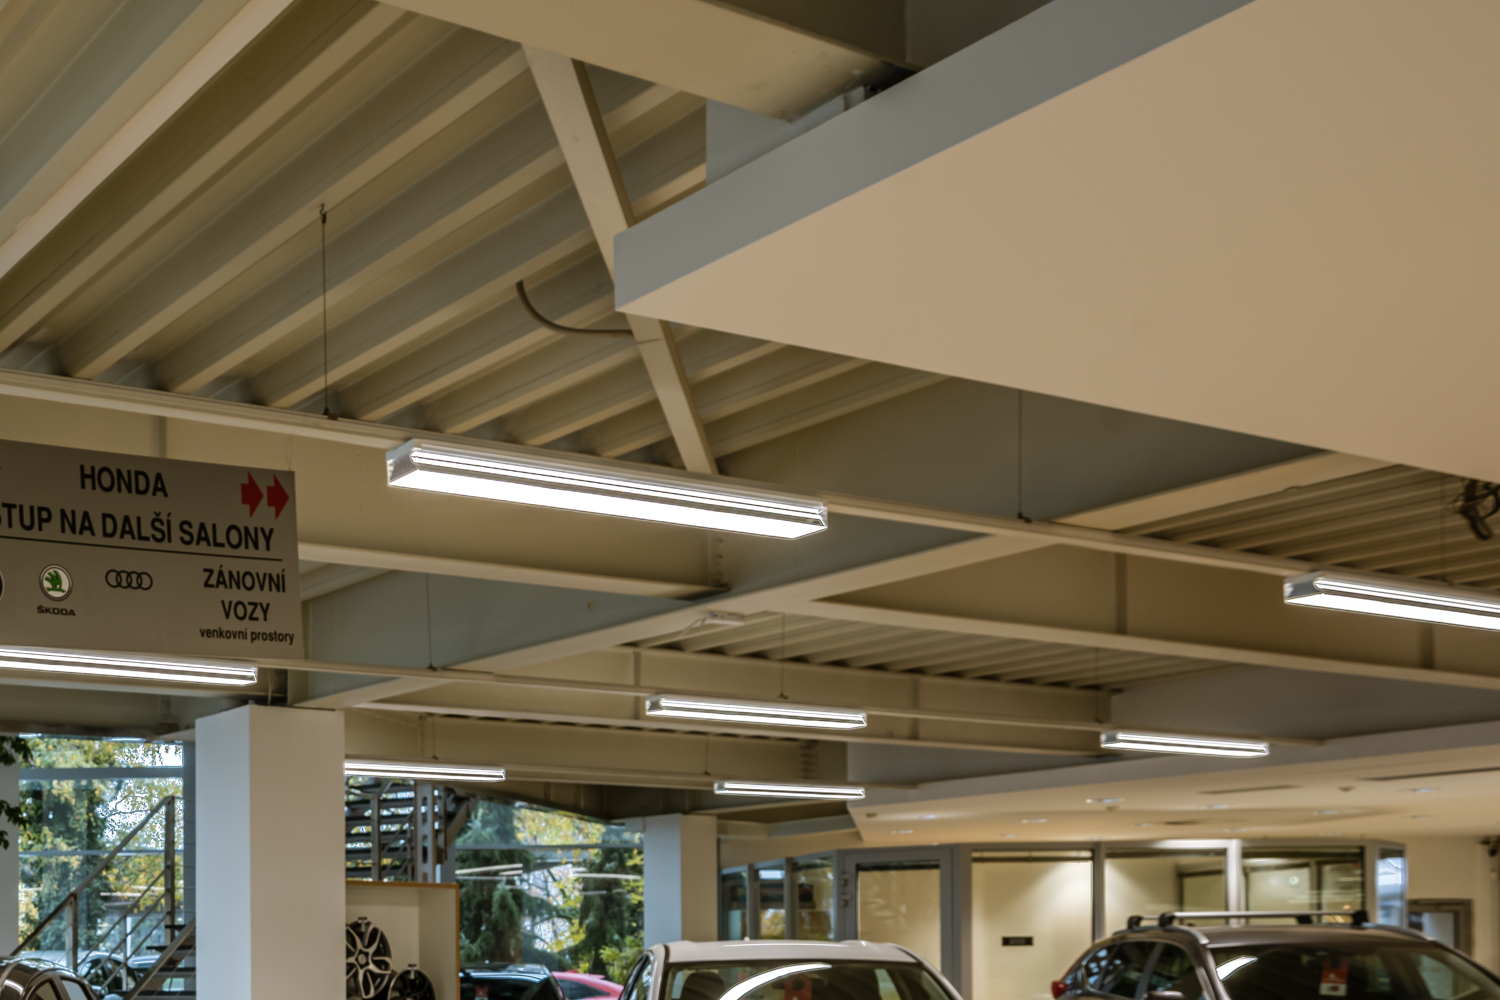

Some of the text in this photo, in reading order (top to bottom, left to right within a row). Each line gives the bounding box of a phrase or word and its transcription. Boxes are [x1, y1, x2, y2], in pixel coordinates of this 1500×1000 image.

[80, 464, 169, 497] HONDA
[60, 508, 95, 537] NA
[102, 511, 172, 544] DALŠÍ
[179, 519, 275, 552] SALONY
[203, 564, 287, 594] ZÁNOVNÍ
[37, 604, 76, 618] ŠKODA
[221, 599, 271, 622] VOZY
[199, 625, 295, 646] venkovní prostory
